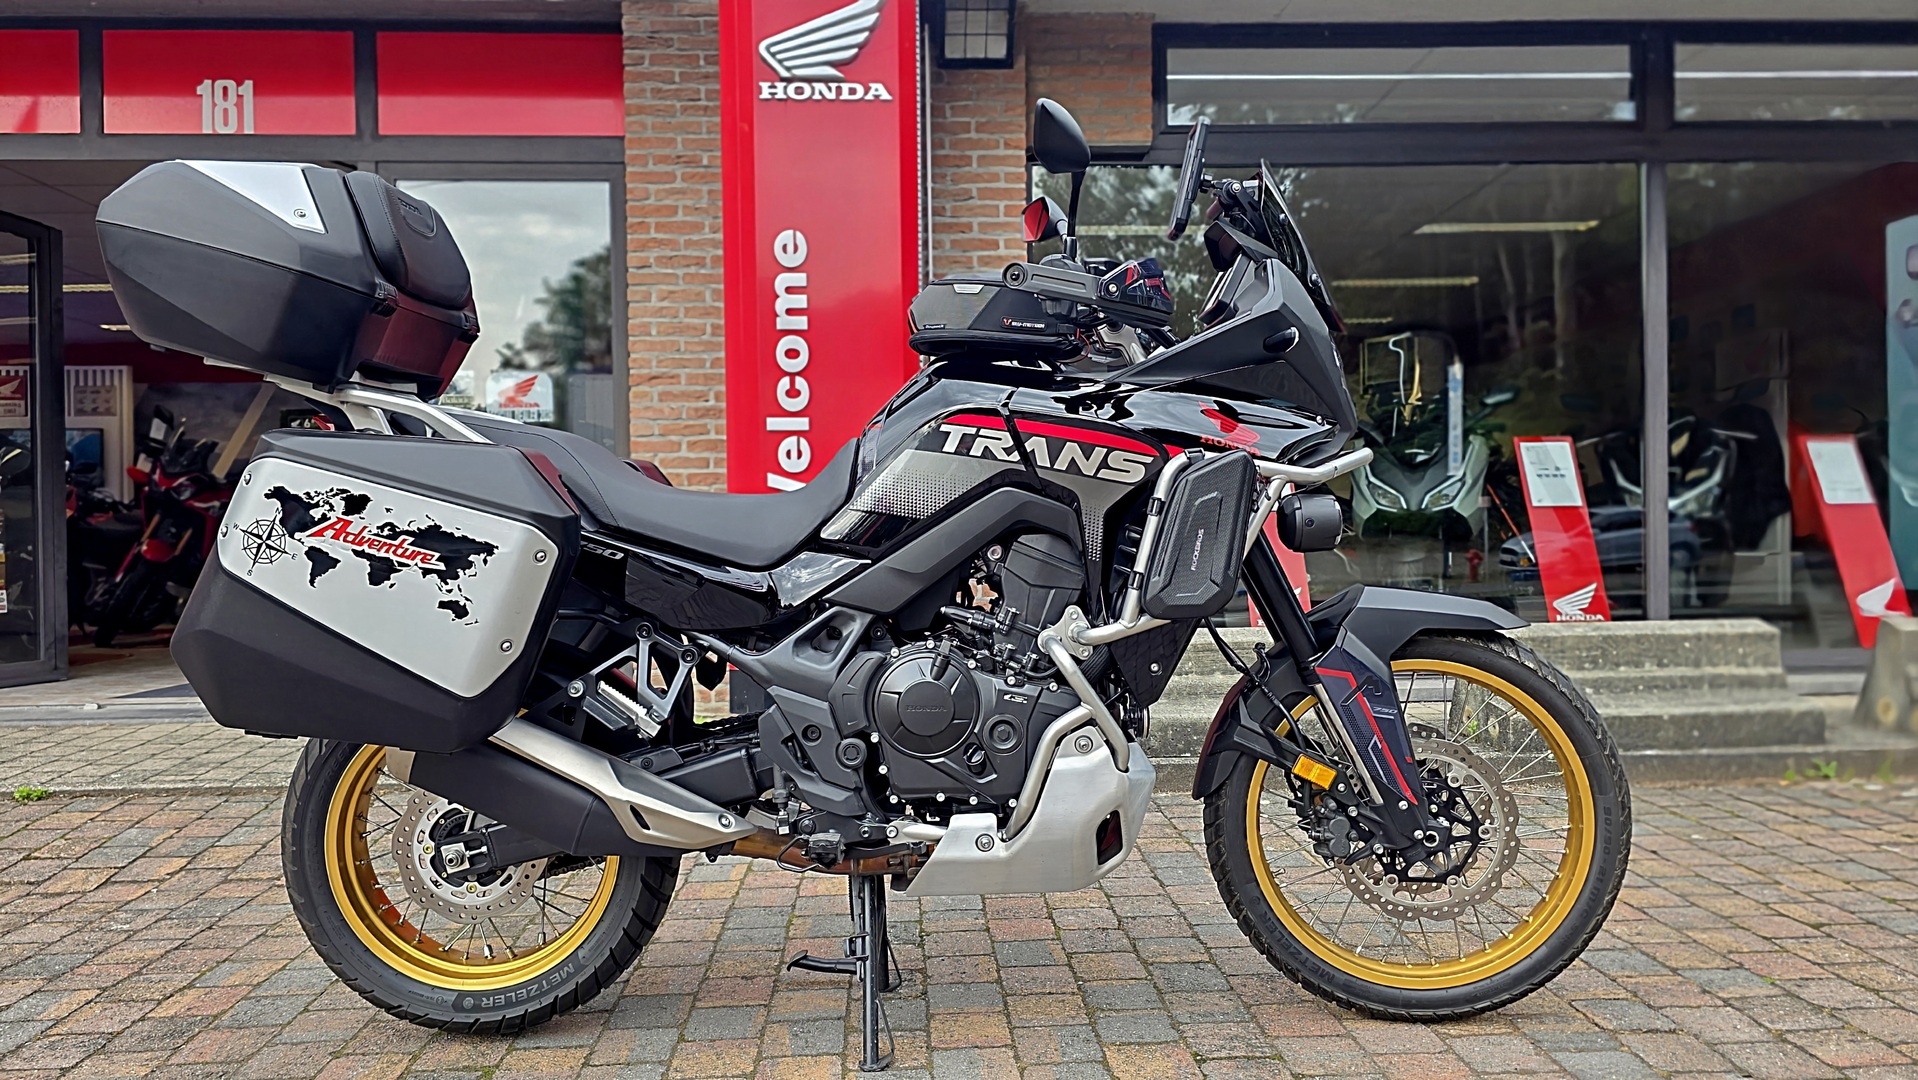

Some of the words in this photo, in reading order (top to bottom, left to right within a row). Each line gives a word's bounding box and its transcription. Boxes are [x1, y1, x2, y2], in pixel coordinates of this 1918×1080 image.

[196, 79, 255, 134] 181
[758, 81, 893, 100] HONDA
[939, 424, 1154, 484] TRANS
[305, 515, 443, 566] Adventure
[1555, 613, 1605, 622] HONDA
[1373, 706, 1398, 714] 750
[480, 962, 576, 1009] METZELER
